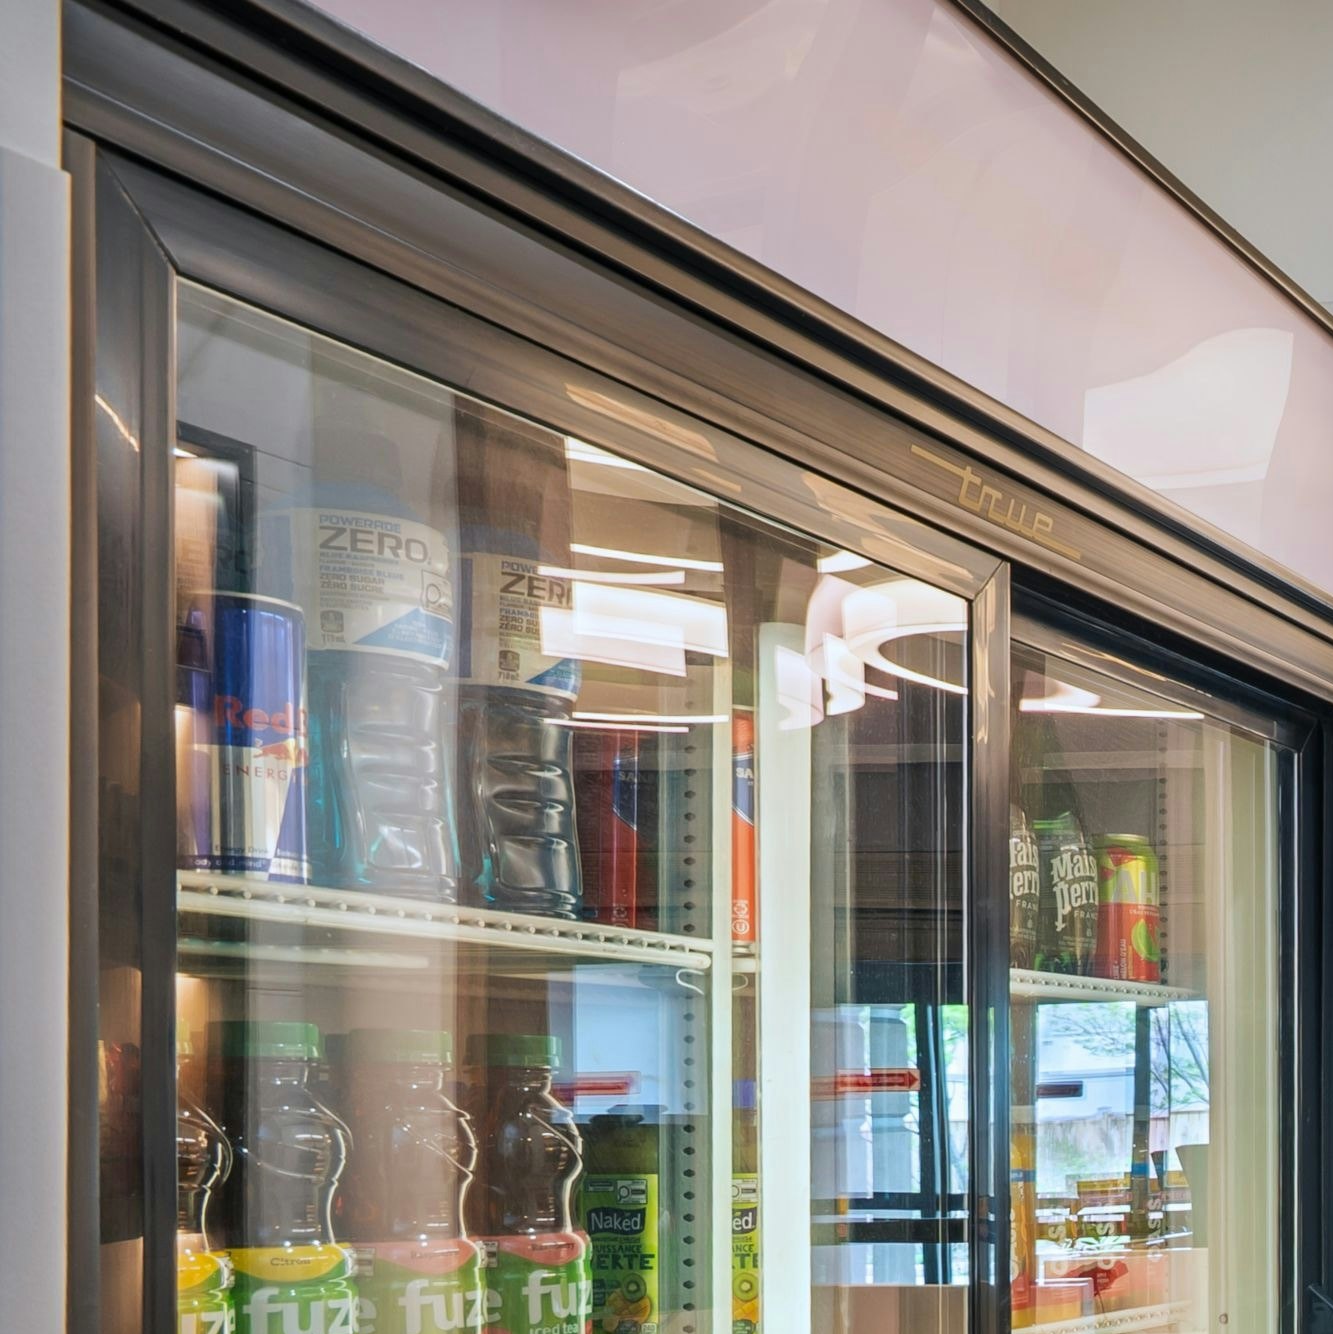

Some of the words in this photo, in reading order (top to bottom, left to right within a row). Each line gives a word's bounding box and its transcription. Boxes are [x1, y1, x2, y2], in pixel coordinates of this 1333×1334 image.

[319, 525, 429, 564] ZERO
[213, 695, 295, 734] Red
[1051, 846, 1099, 885] Mais
[1111, 868, 1158, 904] AH
[591, 1211, 643, 1231] Naked
[597, 1254, 655, 1271] ERTE
[522, 1269, 593, 1325] fuz
